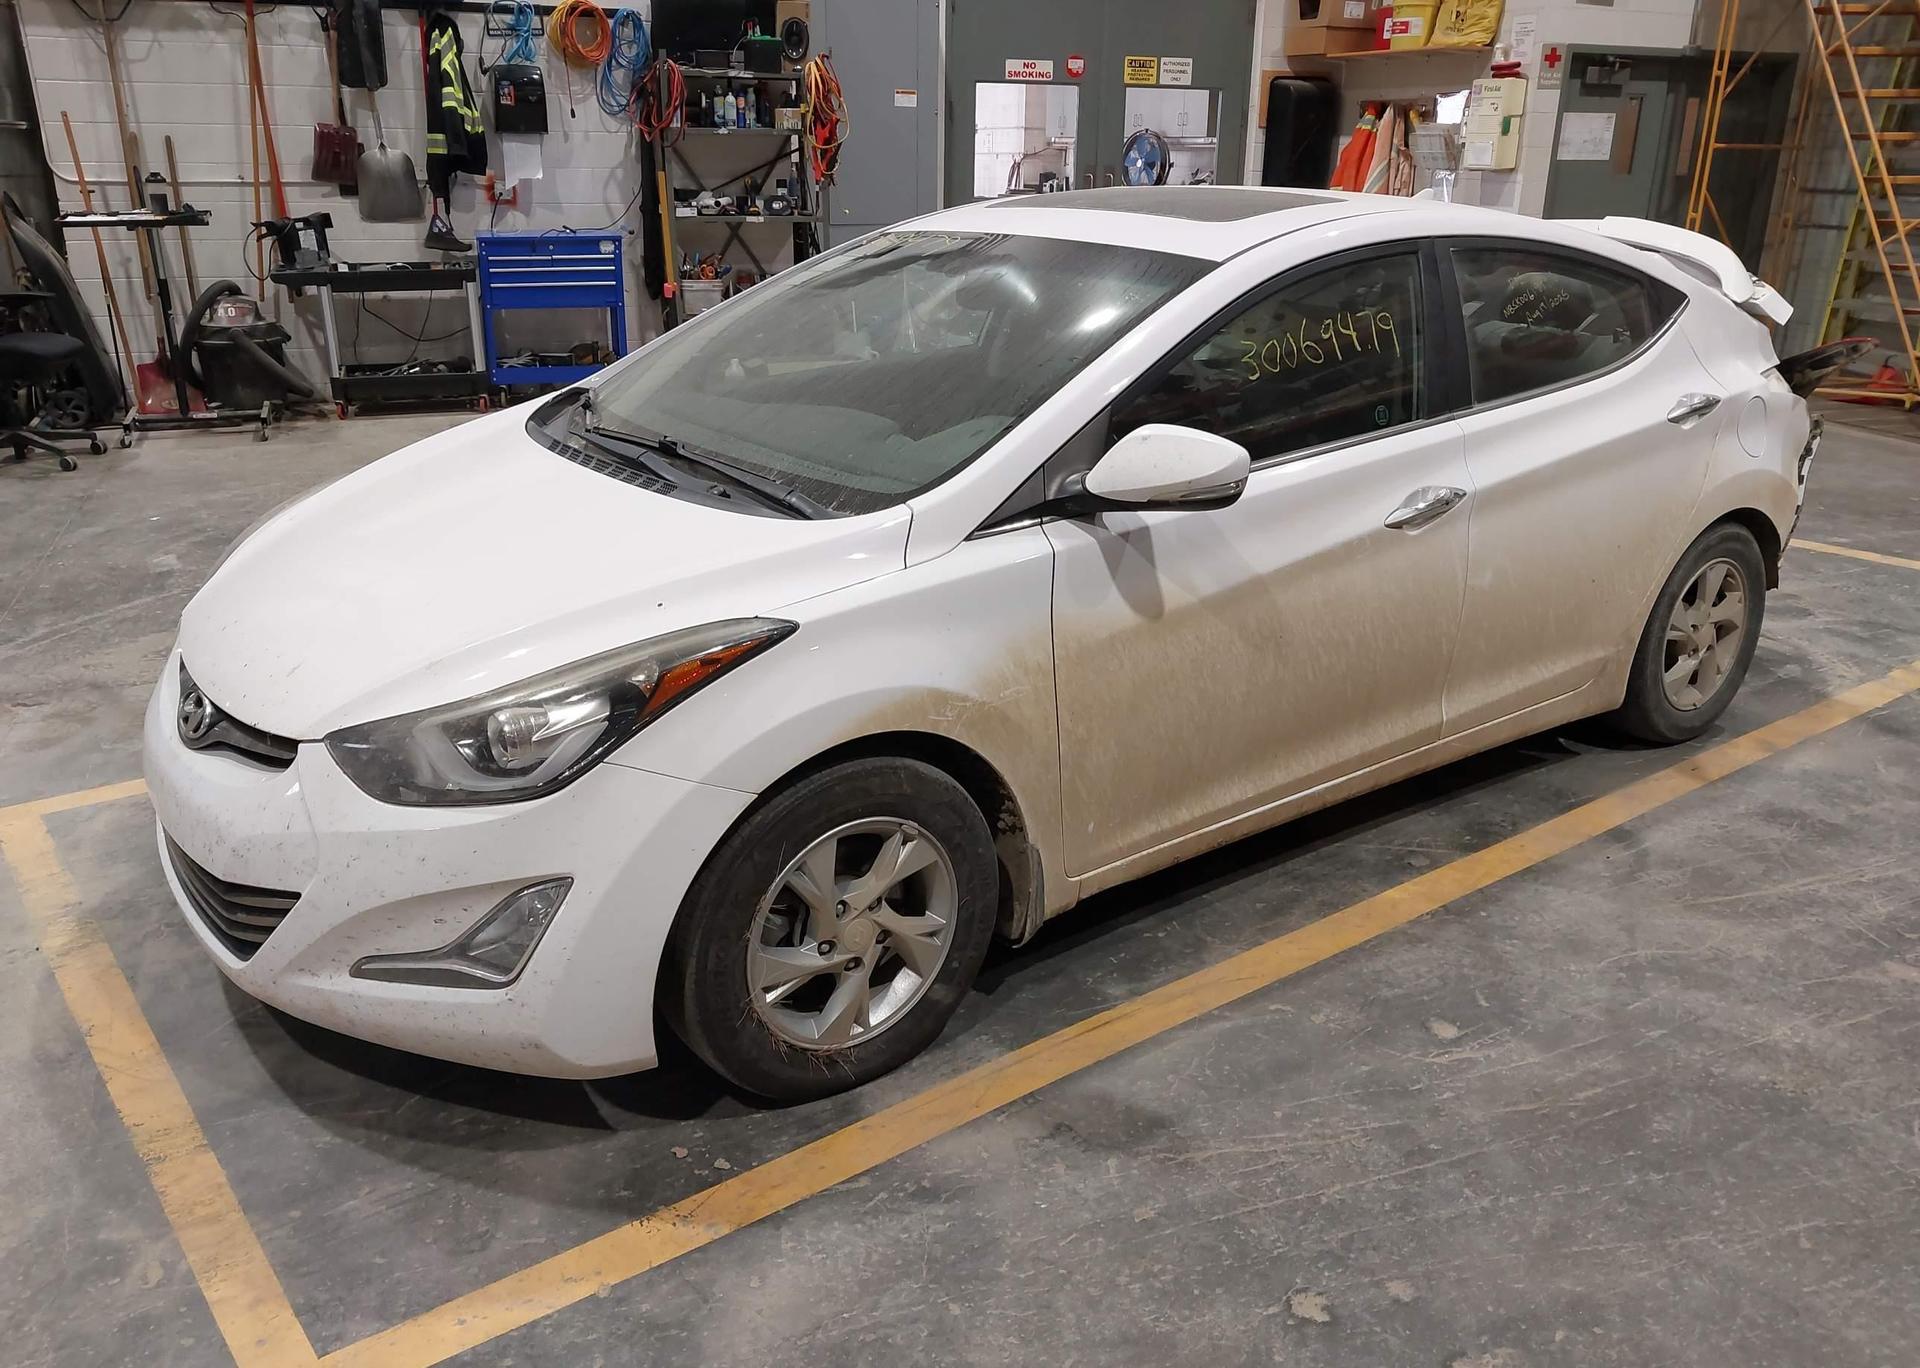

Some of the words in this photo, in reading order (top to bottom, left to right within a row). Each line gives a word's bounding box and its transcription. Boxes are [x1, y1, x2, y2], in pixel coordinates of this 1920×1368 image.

[1023, 61, 1036, 69] NO
[1128, 60, 1154, 68] CAUTION
[1008, 71, 1051, 79] SMOKING
